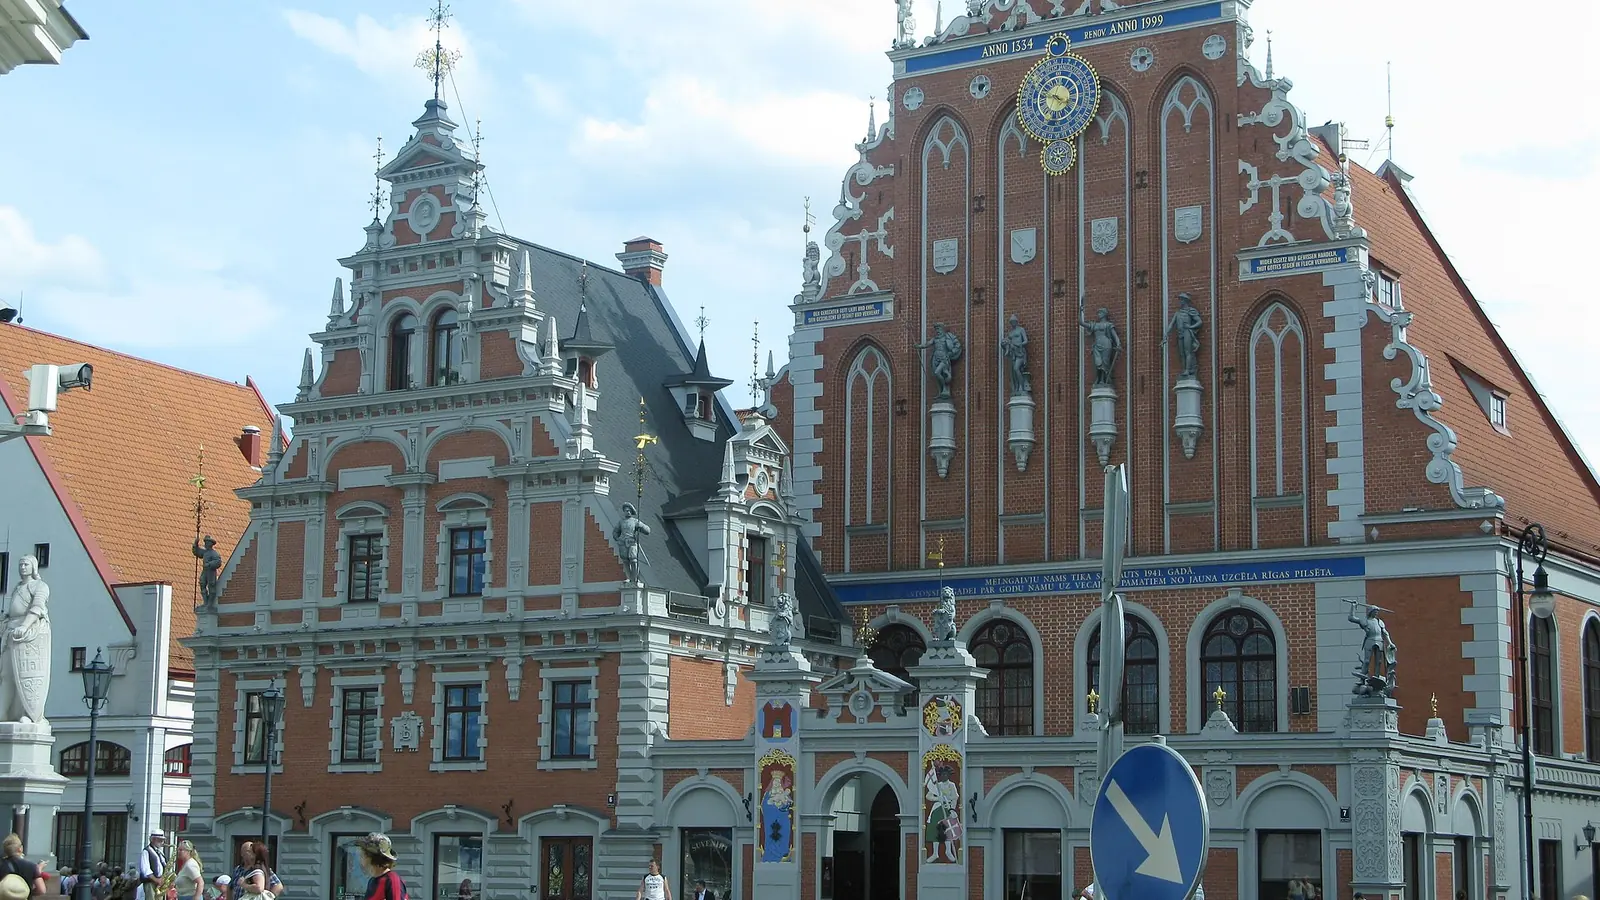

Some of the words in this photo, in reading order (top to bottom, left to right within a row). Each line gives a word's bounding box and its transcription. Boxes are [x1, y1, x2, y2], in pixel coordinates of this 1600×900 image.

[1084, 28, 1107, 40] RENOV.
[1109, 20, 1138, 35] ANNO
[1141, 14, 1164, 29] 1999
[981, 42, 1008, 58] ANNO
[1011, 38, 1034, 55] 1334
[980, 586, 995, 595] PAR
[999, 584, 1024, 593] GODU
[1028, 582, 1054, 591] NAMU
[1059, 582, 1071, 590] UZ
[1121, 576, 1166, 586] PAMATIEM
[1170, 576, 1185, 584] NO
[1188, 574, 1218, 585] JAUNA
[1221, 570, 1258, 582] UZCĒLA
[1261, 569, 1290, 579] RĪGAS
[1294, 567, 1335, 578] PILSĒTA.
[1043, 574, 1067, 582] NAMS
[1071, 573, 1091, 581] TIKA
[1143, 569, 1163, 578] 1941.
[1167, 566, 1196, 576] GADĀ.
